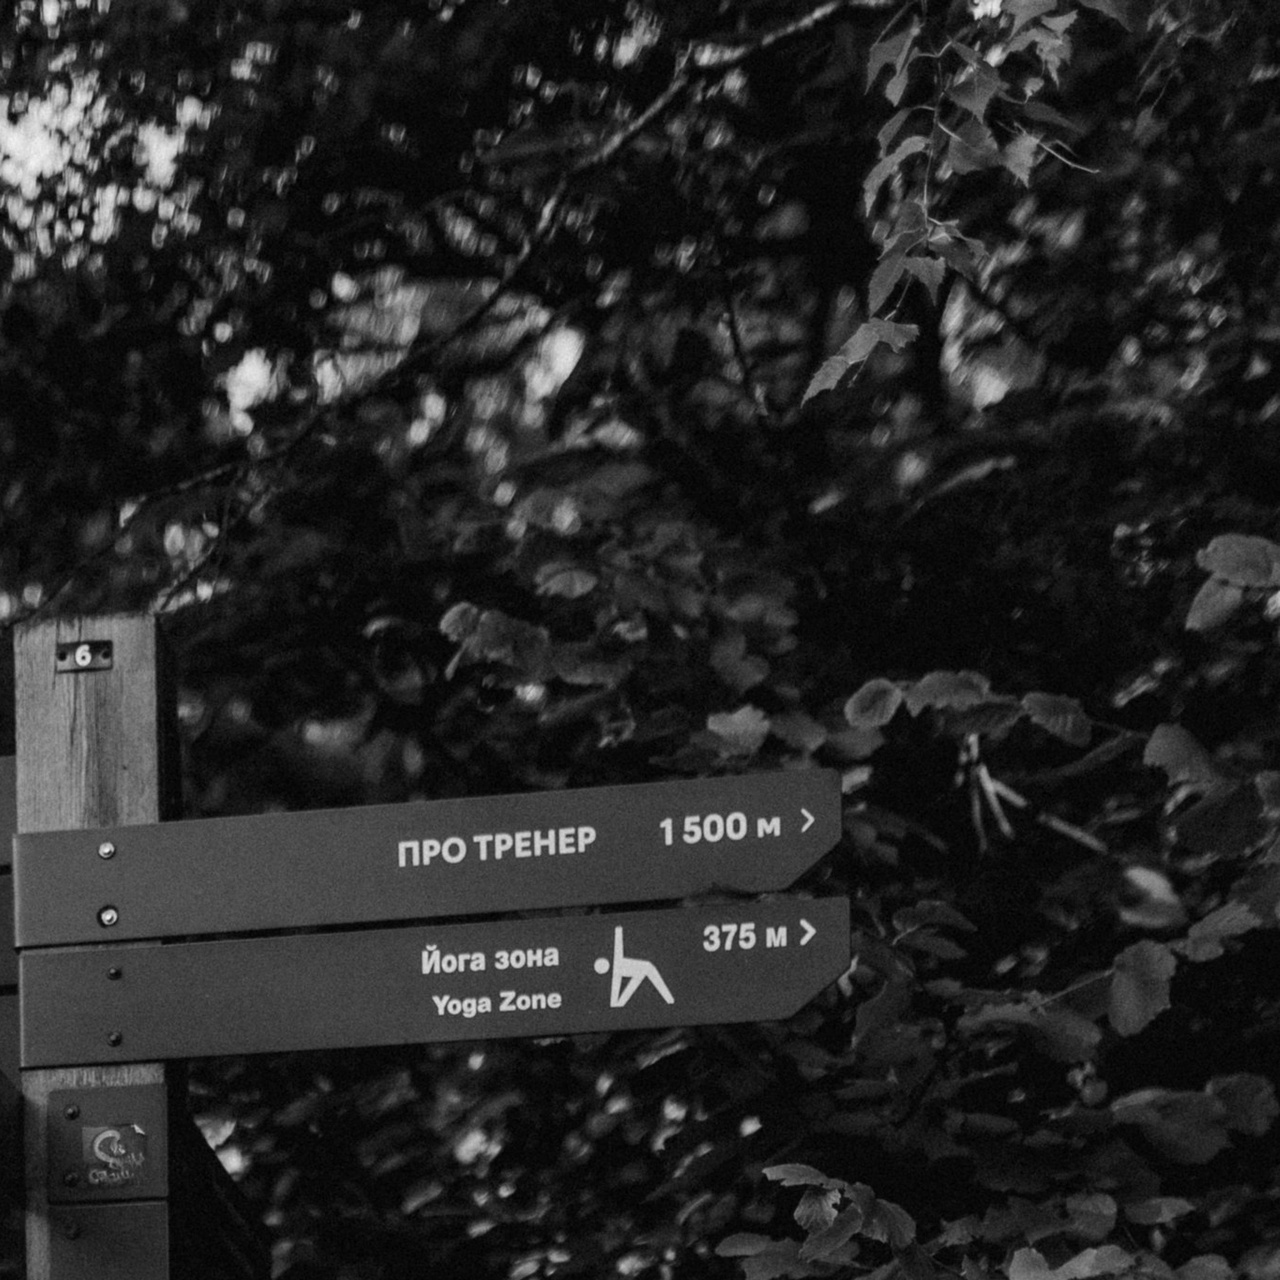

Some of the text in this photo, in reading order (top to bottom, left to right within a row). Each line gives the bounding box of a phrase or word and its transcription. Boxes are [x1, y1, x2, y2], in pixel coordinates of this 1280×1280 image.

[75, 643, 93, 667] 6
[399, 827, 596, 867] ПРО ТРЕНЕР
[703, 923, 756, 951] 375
[422, 945, 559, 974] Йога зона
[433, 991, 561, 1018] Yoga Zone
